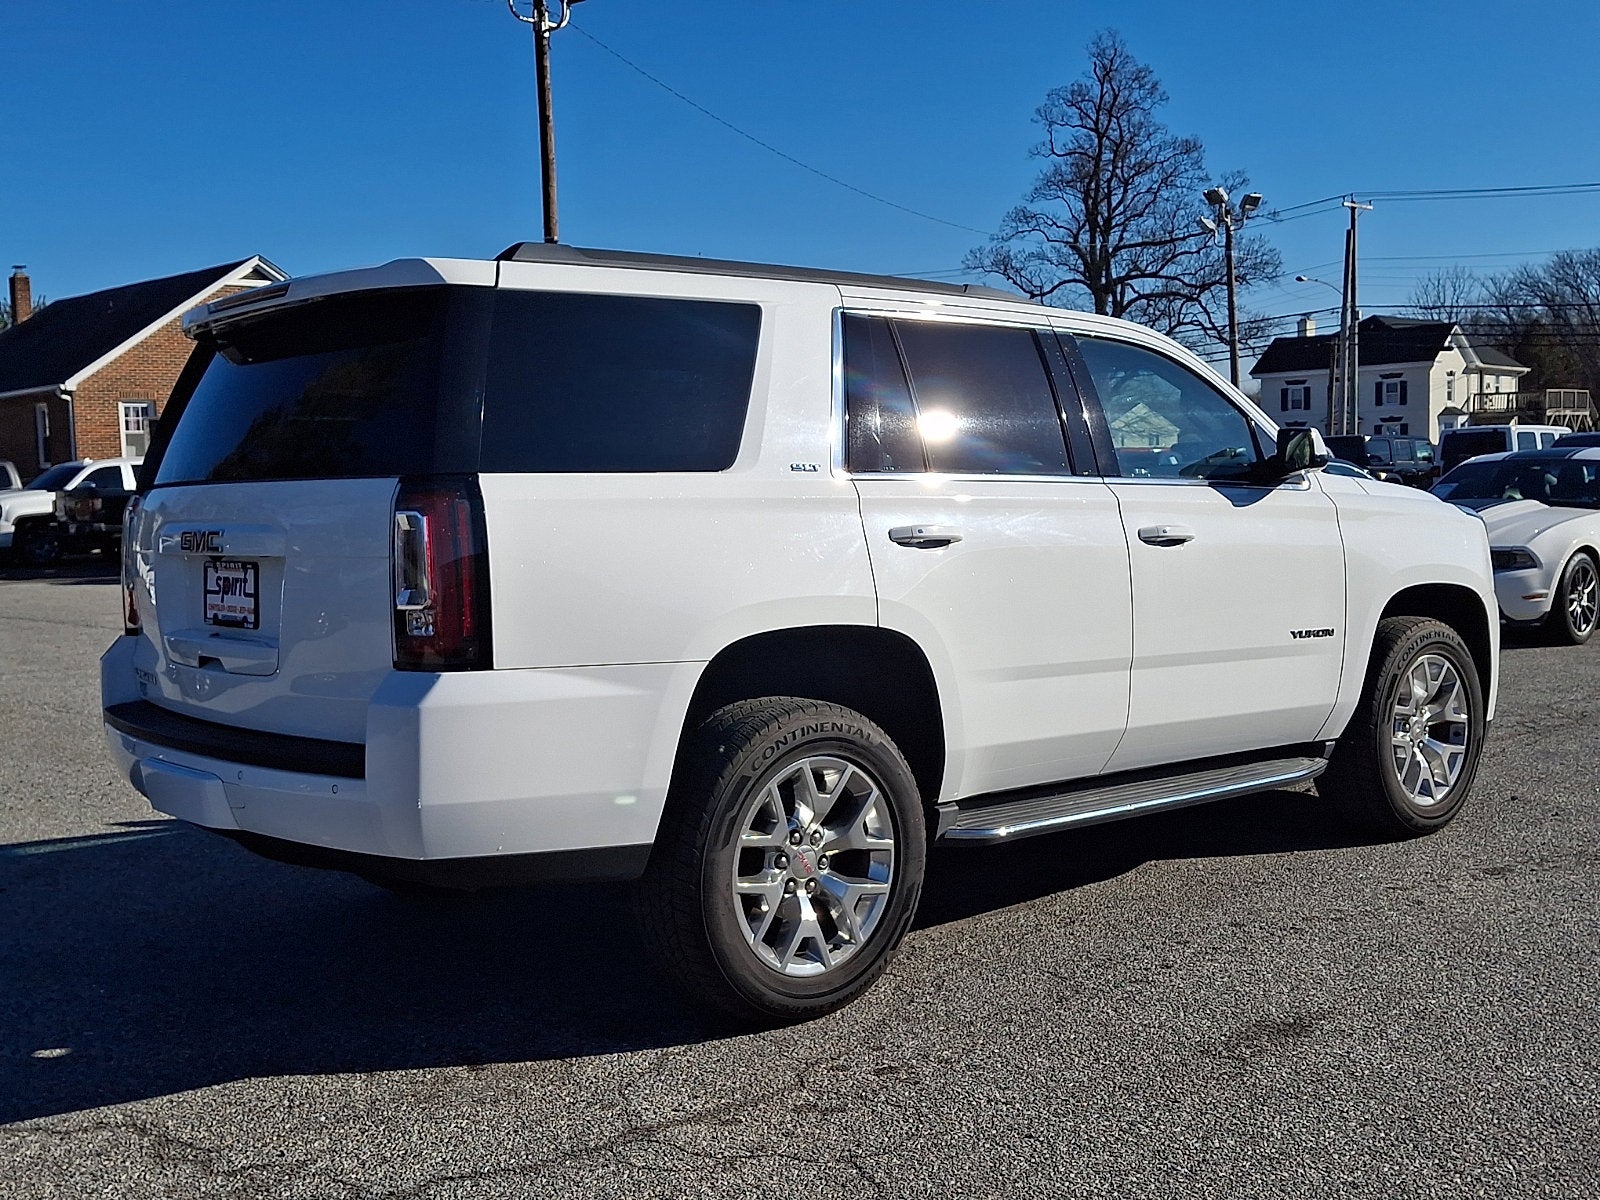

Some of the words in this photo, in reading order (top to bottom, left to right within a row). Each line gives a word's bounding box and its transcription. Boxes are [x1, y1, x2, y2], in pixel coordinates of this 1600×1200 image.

[181, 530, 225, 552] GMC
[212, 573, 252, 603] spirit
[1290, 628, 1334, 639] YUKON
[1398, 631, 1459, 670] CONTINENTAL
[752, 721, 873, 772] CONTINENTAL
